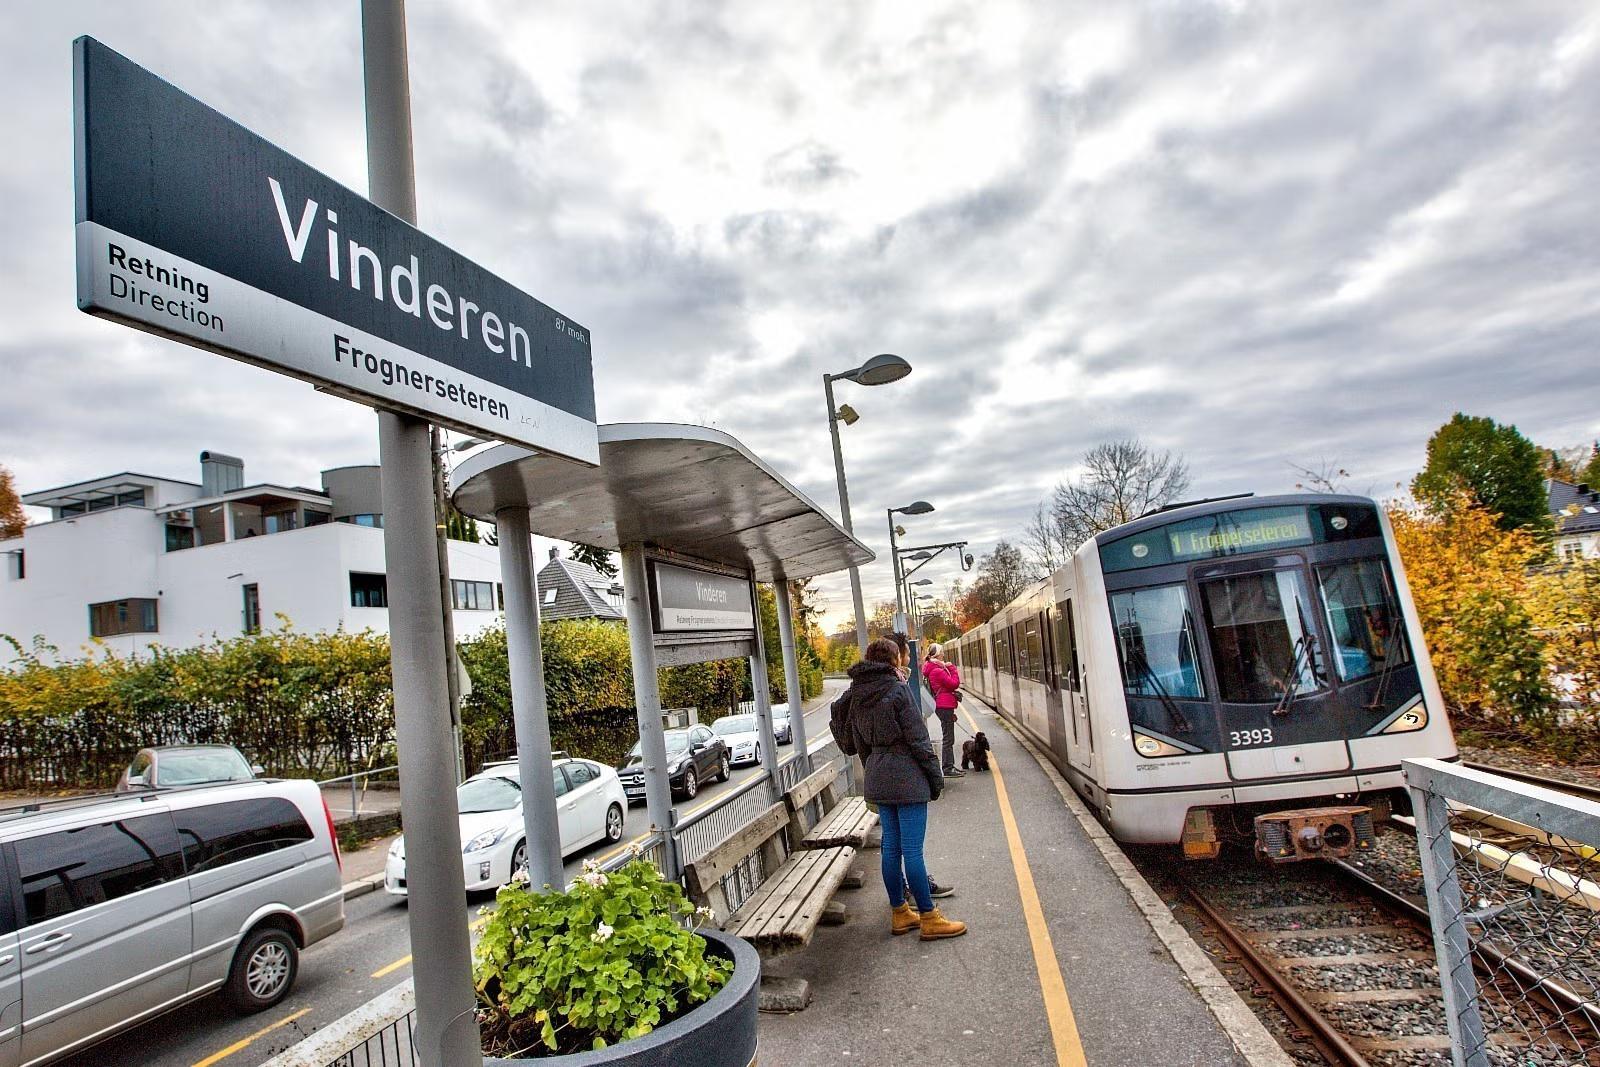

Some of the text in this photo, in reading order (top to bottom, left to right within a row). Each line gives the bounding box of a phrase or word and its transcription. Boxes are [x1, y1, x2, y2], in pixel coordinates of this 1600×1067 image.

[108, 243, 210, 304] Retning
[267, 177, 533, 368] Vinderen
[109, 273, 224, 333] Direction
[555, 317, 566, 332] 87
[334, 334, 509, 421] Frognerseteren
[1170, 531, 1181, 553] 1
[696, 581, 727, 603] Vinderen
[1230, 728, 1273, 747] 3393
